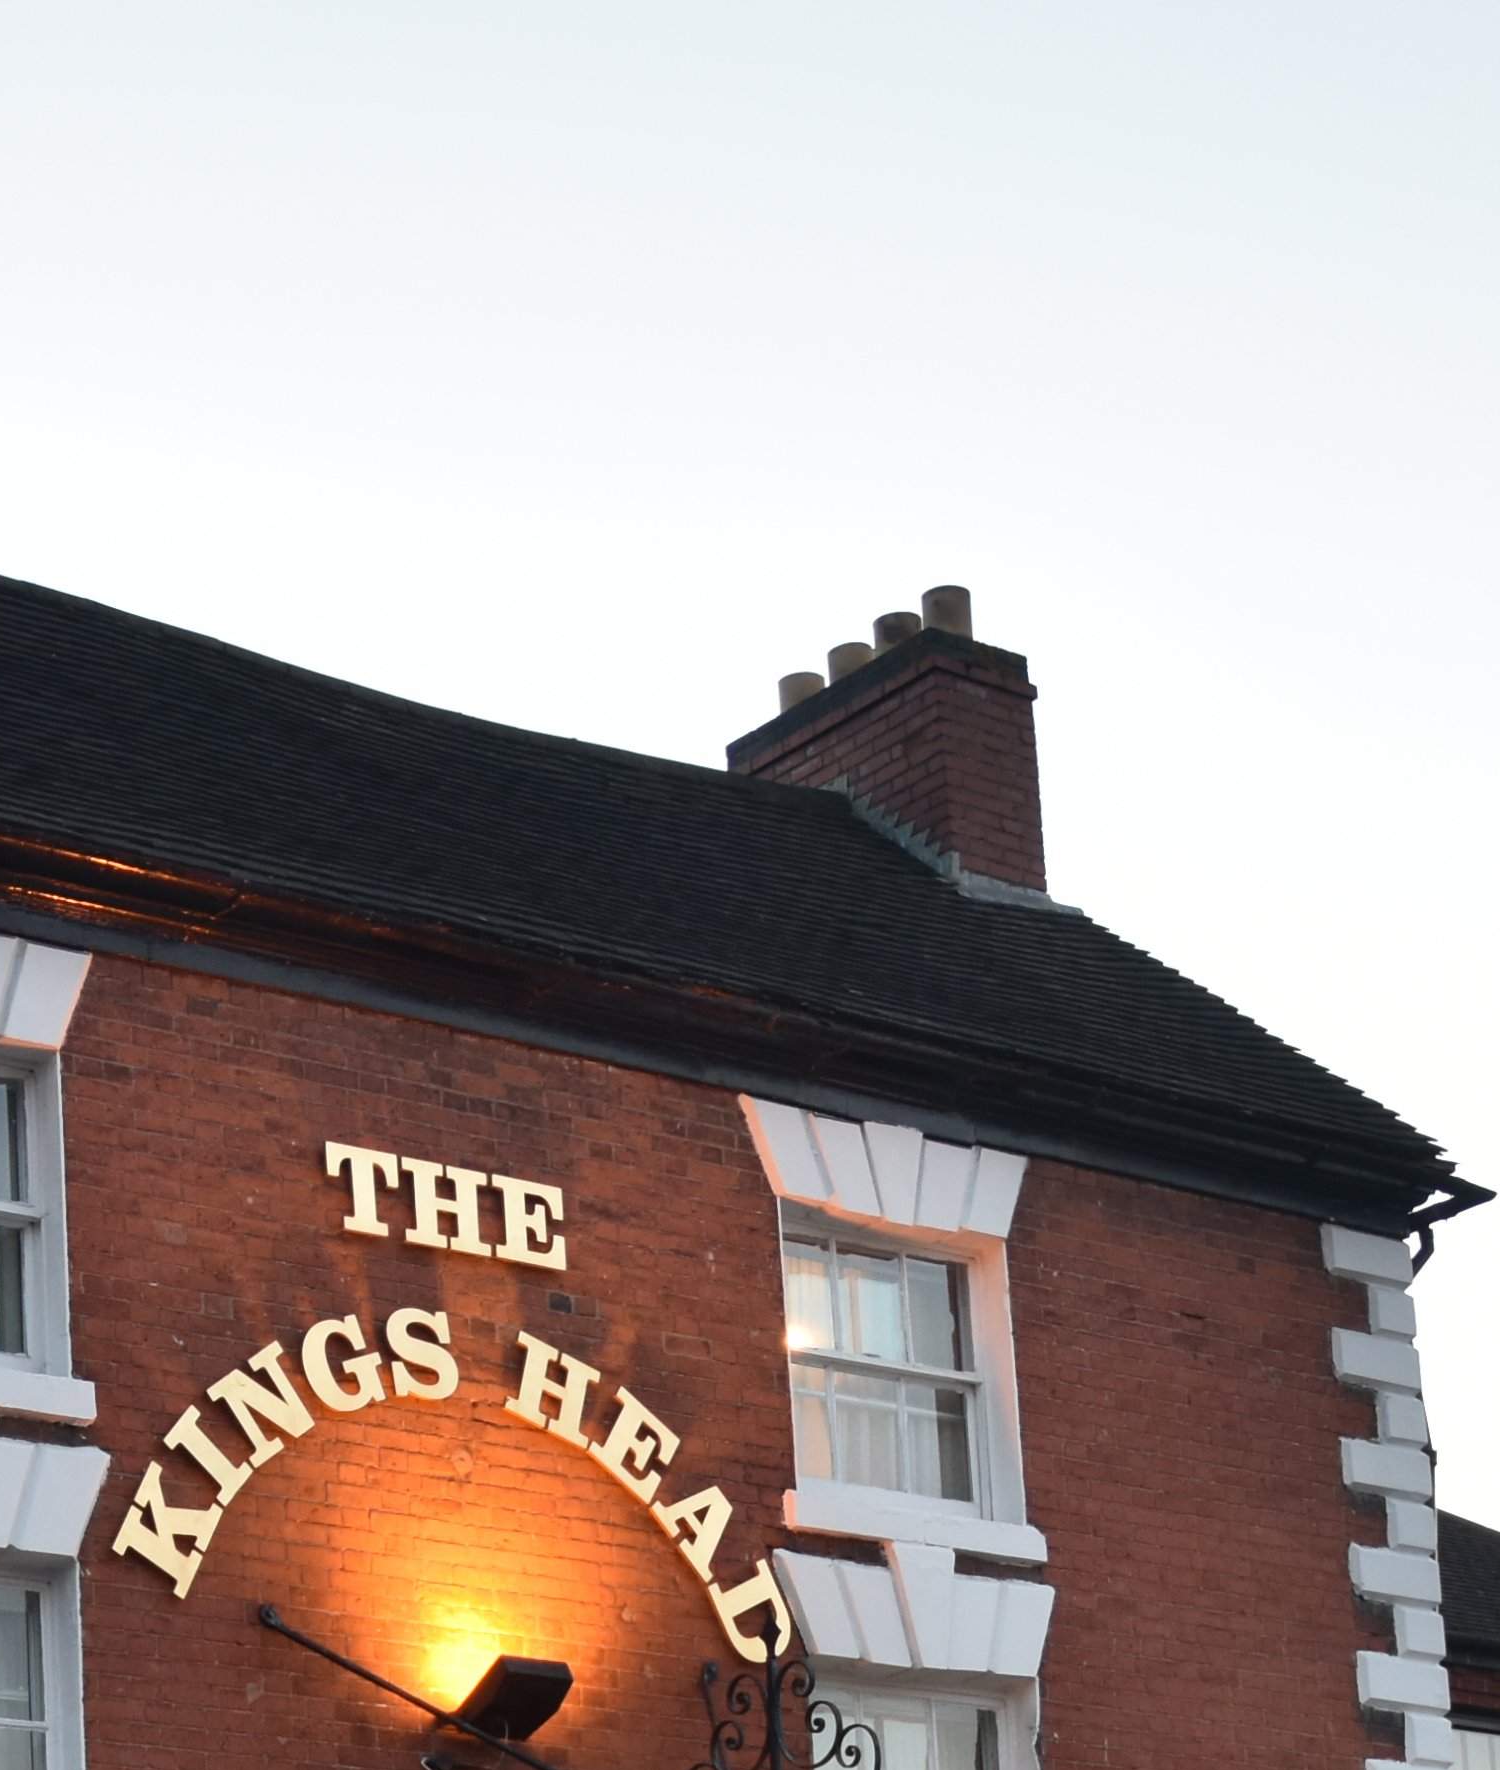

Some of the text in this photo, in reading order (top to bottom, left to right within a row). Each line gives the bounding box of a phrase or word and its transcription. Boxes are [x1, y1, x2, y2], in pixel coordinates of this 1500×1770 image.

[324, 1141, 567, 1271] THE
[112, 1308, 793, 1664] KINGS HEAD
